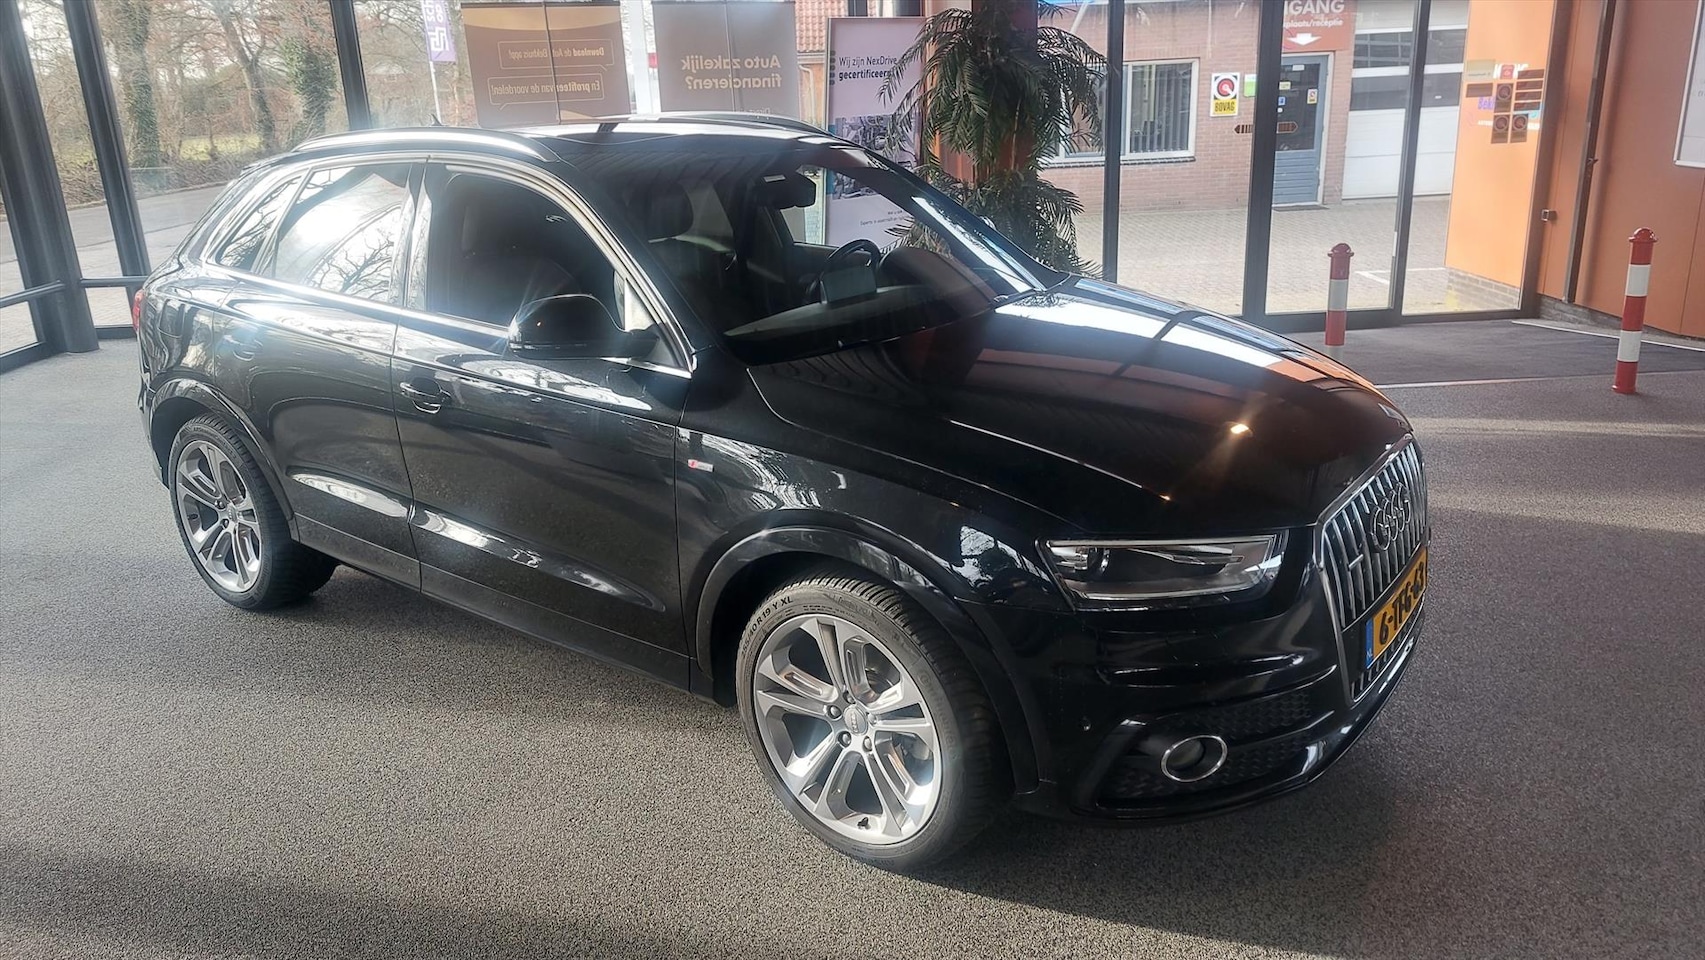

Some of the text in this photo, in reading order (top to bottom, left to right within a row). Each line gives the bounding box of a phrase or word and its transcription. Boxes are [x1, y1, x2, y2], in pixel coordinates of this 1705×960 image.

[839, 55, 898, 69] Wij zijn NexDrive
[838, 69, 891, 81] gecertificeer
[1214, 101, 1235, 113] BOVAG
[756, 616, 763, 625] R
[762, 607, 772, 618] 19
[772, 601, 778, 610] Y
[780, 595, 794, 606] XL
